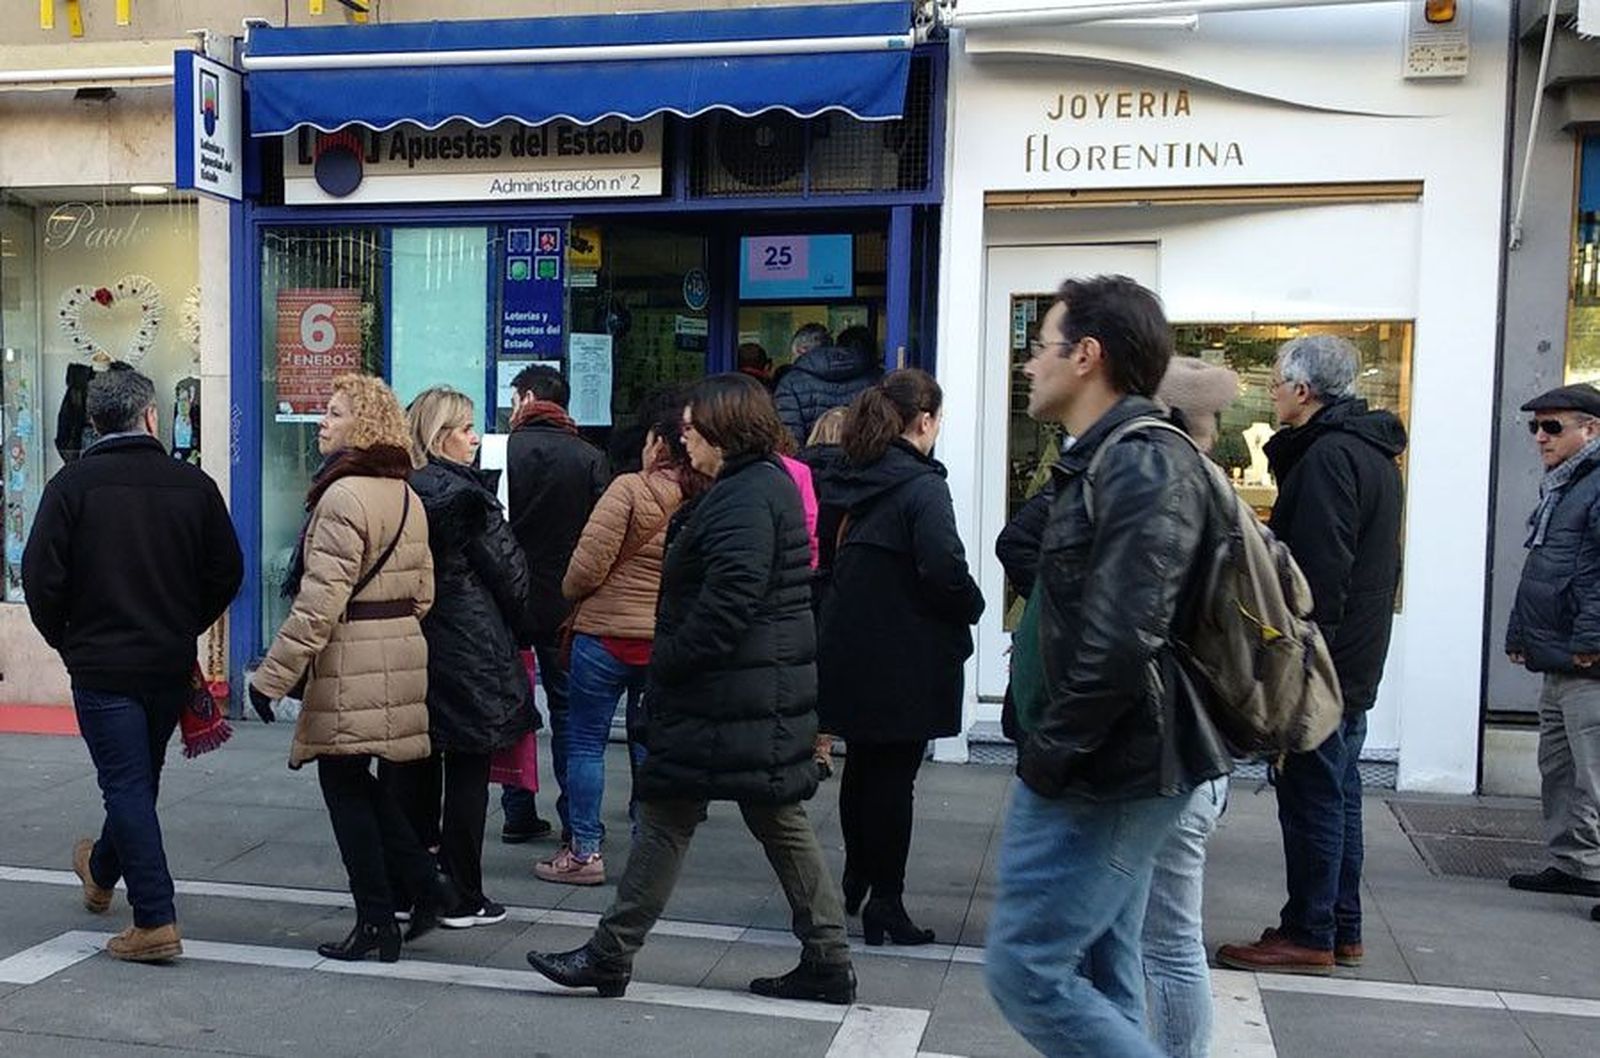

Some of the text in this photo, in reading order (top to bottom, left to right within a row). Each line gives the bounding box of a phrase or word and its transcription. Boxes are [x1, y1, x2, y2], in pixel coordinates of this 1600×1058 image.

[389, 118, 645, 168] Apuestas del Estado
[490, 176, 606, 195] Administración
[630, 174, 641, 190] 2
[764, 246, 793, 266] 25
[300, 302, 337, 353] 6
[541, 312, 549, 324] y
[503, 338, 535, 349] Estado
[293, 354, 345, 366] ENERO
